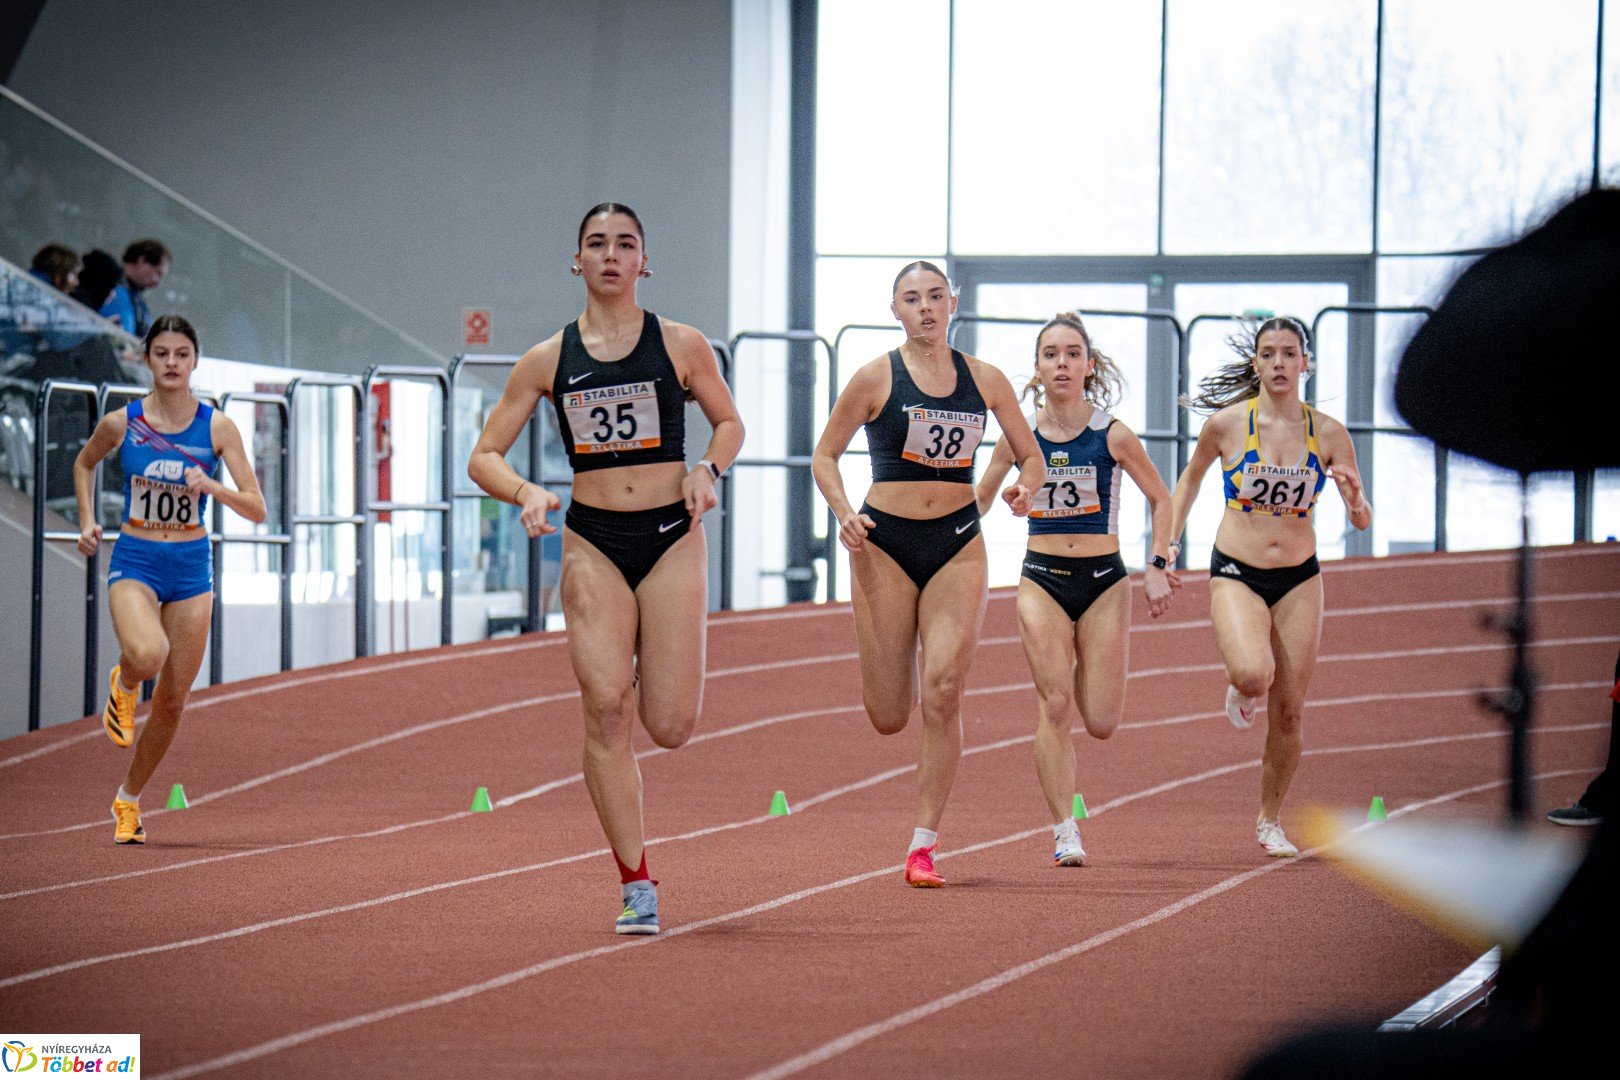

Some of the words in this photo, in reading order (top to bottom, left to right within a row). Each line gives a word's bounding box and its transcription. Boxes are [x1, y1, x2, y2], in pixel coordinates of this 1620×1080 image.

[583, 384, 648, 401] STABILITA
[590, 402, 637, 443] 35
[927, 410, 979, 424] STABILITA
[925, 424, 965, 459] 38
[917, 457, 960, 467] ATLETIKA
[1260, 465, 1311, 476] STABILITA
[1047, 467, 1091, 476] TABILITA
[1042, 481, 1081, 509] 73
[1250, 478, 1306, 507] 261
[140, 490, 192, 523] 108
[1042, 508, 1086, 518] ATLETIKA
